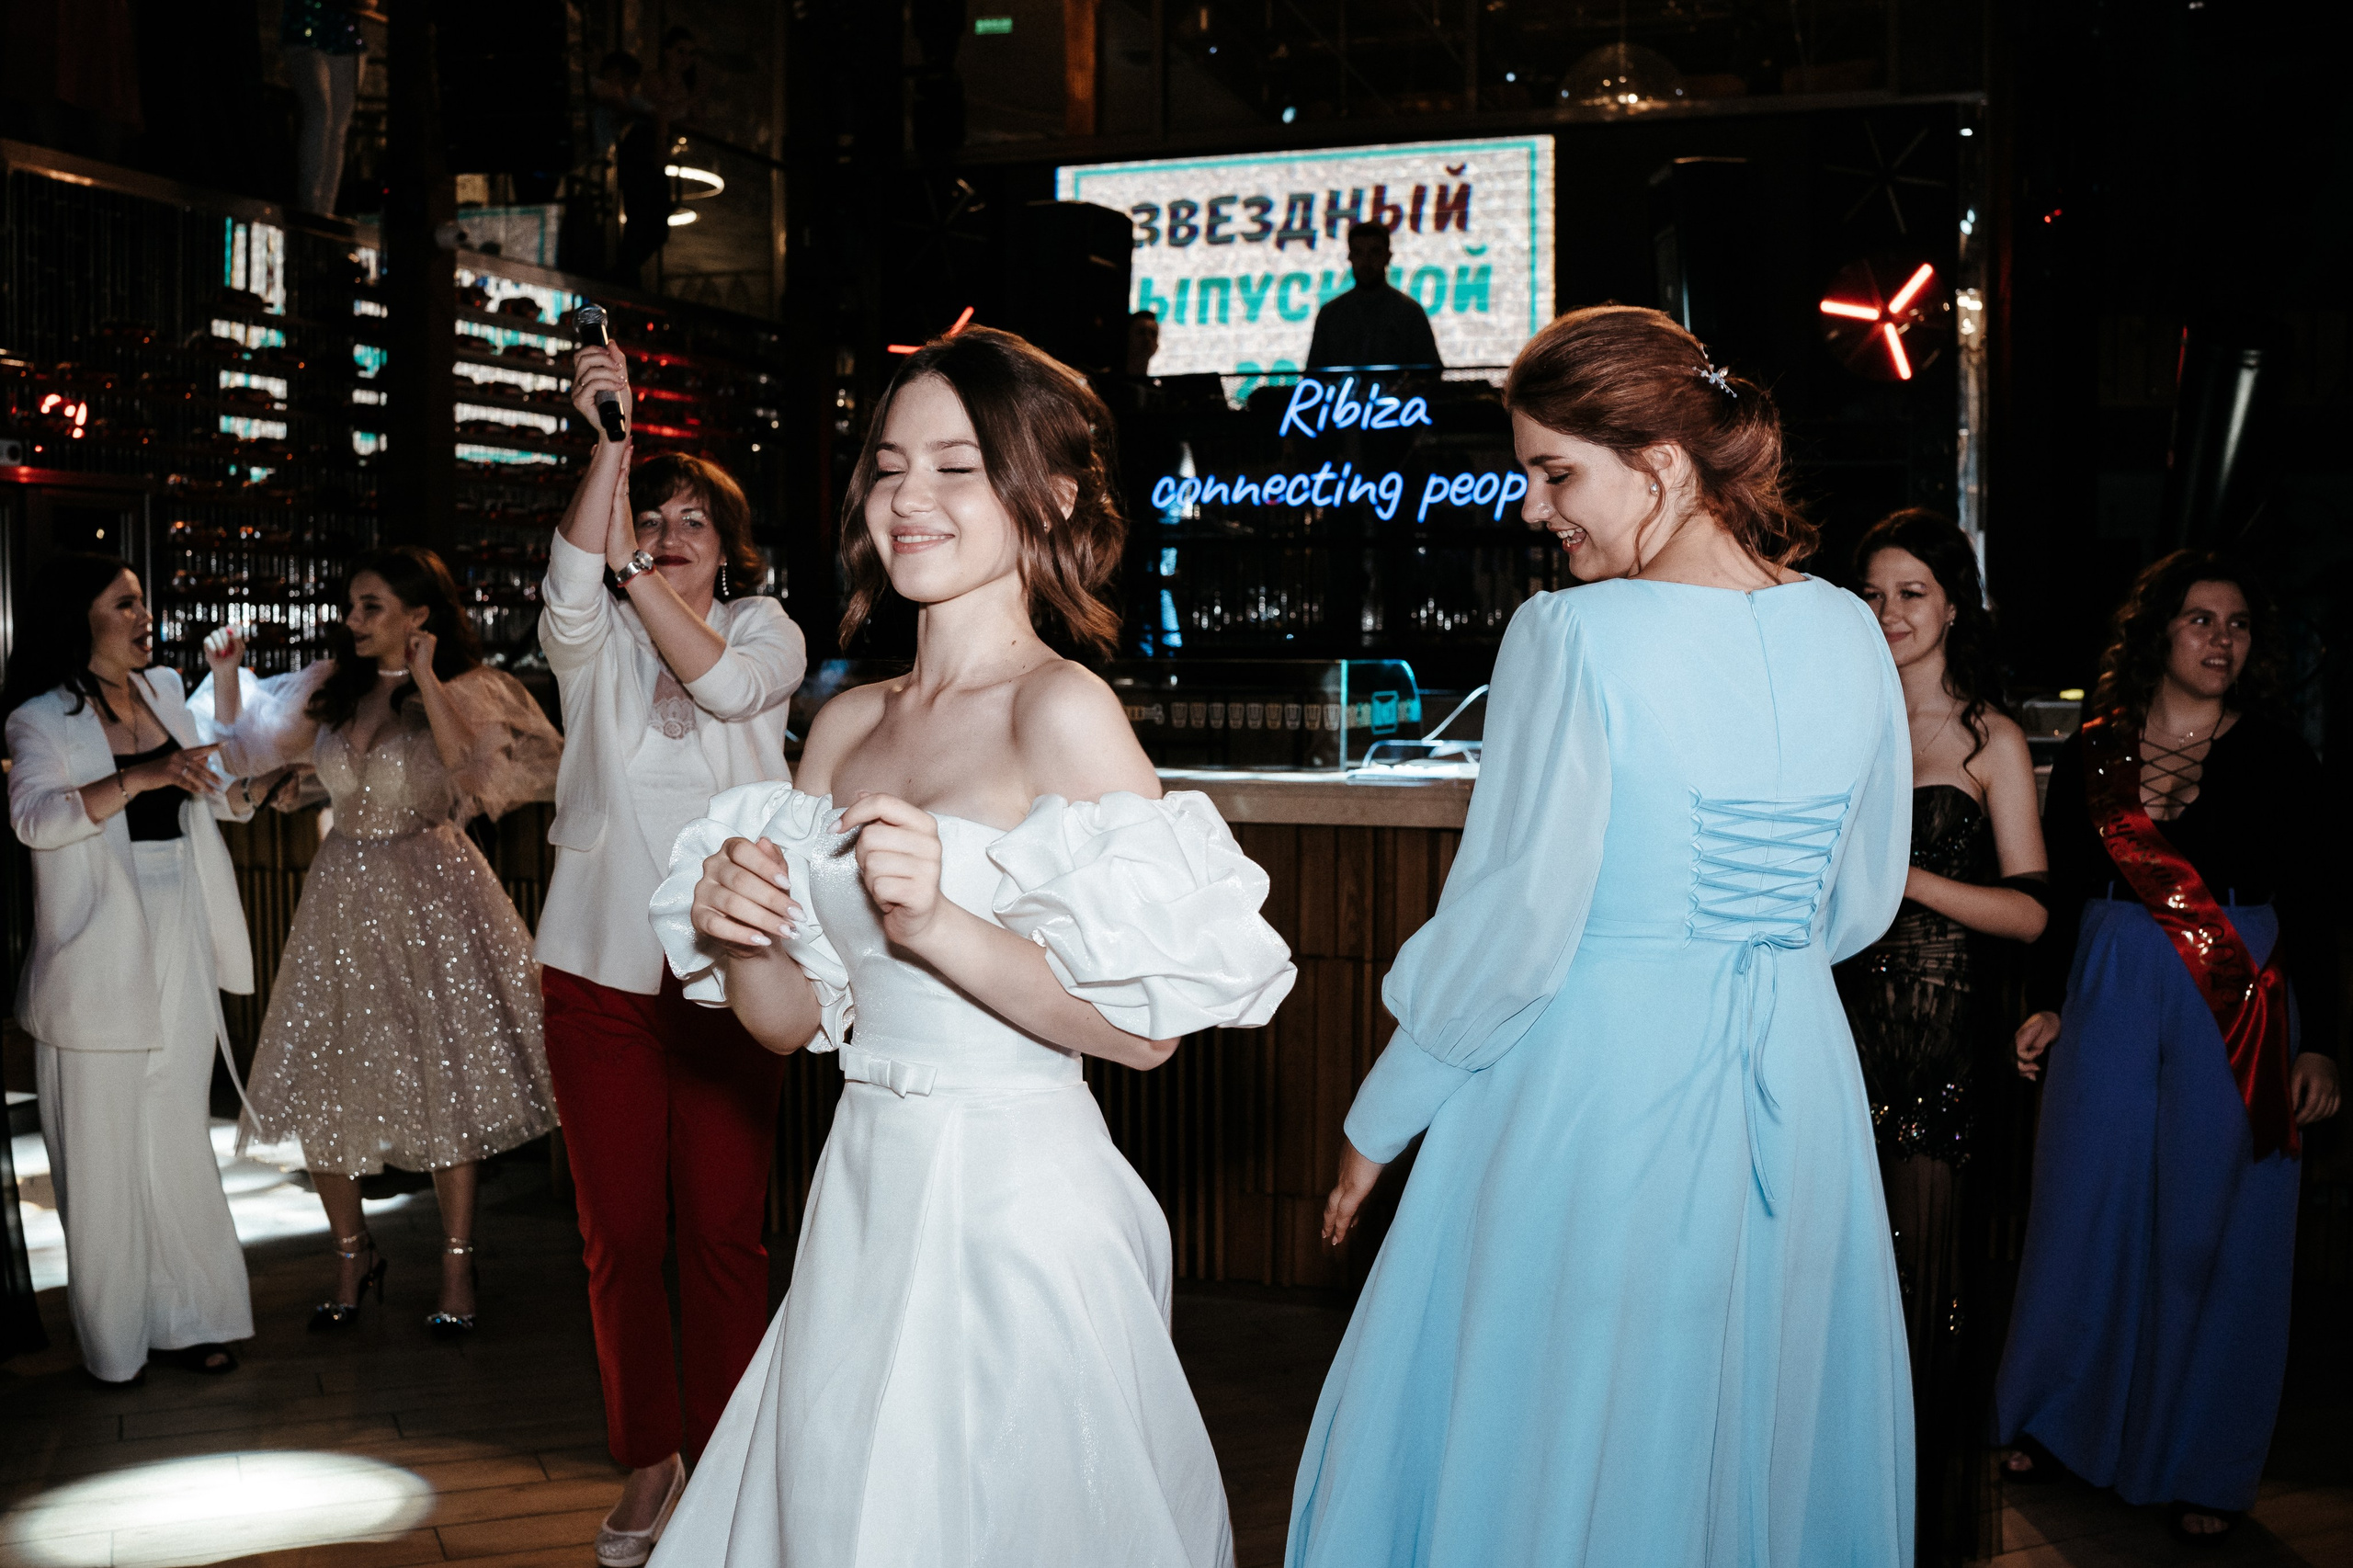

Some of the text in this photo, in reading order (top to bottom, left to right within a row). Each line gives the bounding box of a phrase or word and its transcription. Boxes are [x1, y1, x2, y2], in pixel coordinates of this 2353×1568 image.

[1131, 162, 1472, 250] ЗВЕЗДНЫЙ
[1131, 244, 1494, 326] ЫПУСКОЙ
[1279, 375, 1433, 438] Ribiza
[1151, 460, 1529, 523] connecting peop
